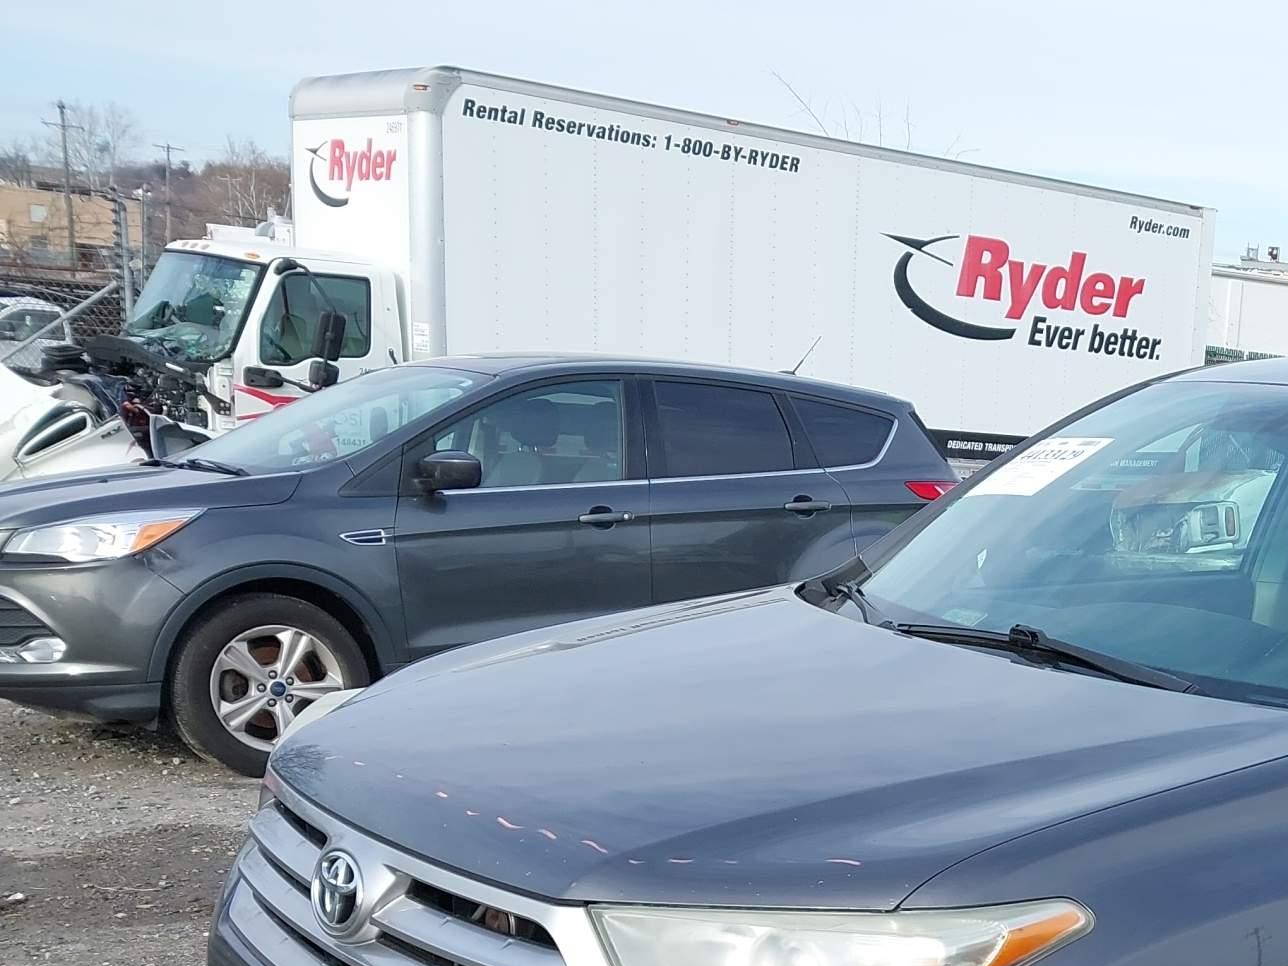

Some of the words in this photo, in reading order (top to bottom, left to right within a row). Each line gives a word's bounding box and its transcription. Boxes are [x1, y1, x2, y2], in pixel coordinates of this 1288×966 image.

[462, 98, 525, 126] Rental
[531, 112, 658, 149] Reservations:
[664, 135, 801, 174] 1-800-BY-RYDER
[328, 137, 397, 192] Ryder
[1130, 216, 1190, 239] Ryder.com
[956, 235, 1146, 320] Ryder
[1028, 316, 1085, 351] Ever
[1088, 323, 1162, 361] better.
[947, 440, 983, 451] DEDICATED
